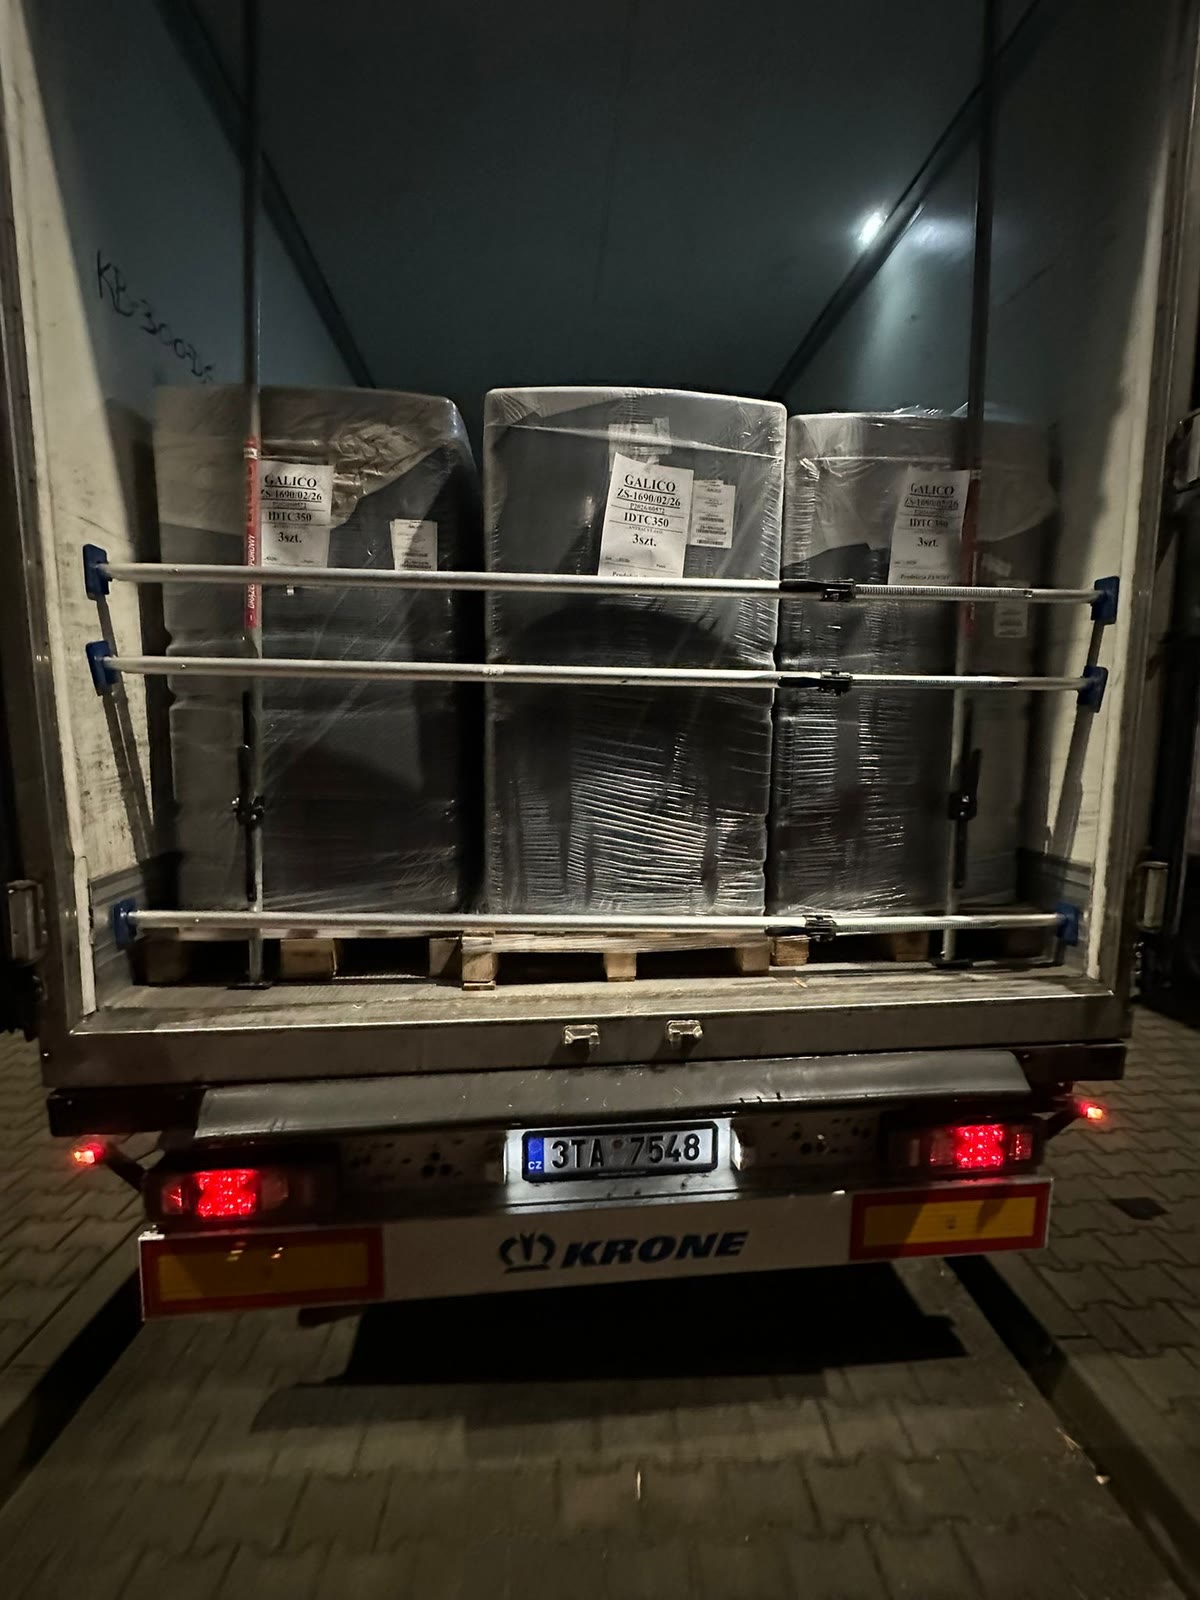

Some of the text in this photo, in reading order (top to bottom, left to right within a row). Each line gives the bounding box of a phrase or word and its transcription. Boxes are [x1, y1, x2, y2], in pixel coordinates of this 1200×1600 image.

[264, 474, 317, 488] GALICO
[624, 474, 676, 494] GALICO
[910, 483, 955, 496] GALICO
[617, 487, 681, 507] ZS-1690/02/26
[268, 511, 312, 522] IDTC350
[624, 512, 669, 528] IDTC350
[277, 531, 302, 544] 3szt.
[632, 534, 657, 547] 3szt.
[917, 537, 939, 548] 3szt.
[551, 1133, 700, 1169] 3TA 7548
[528, 1161, 542, 1170] CZ
[560, 1231, 748, 1269] KRONE
